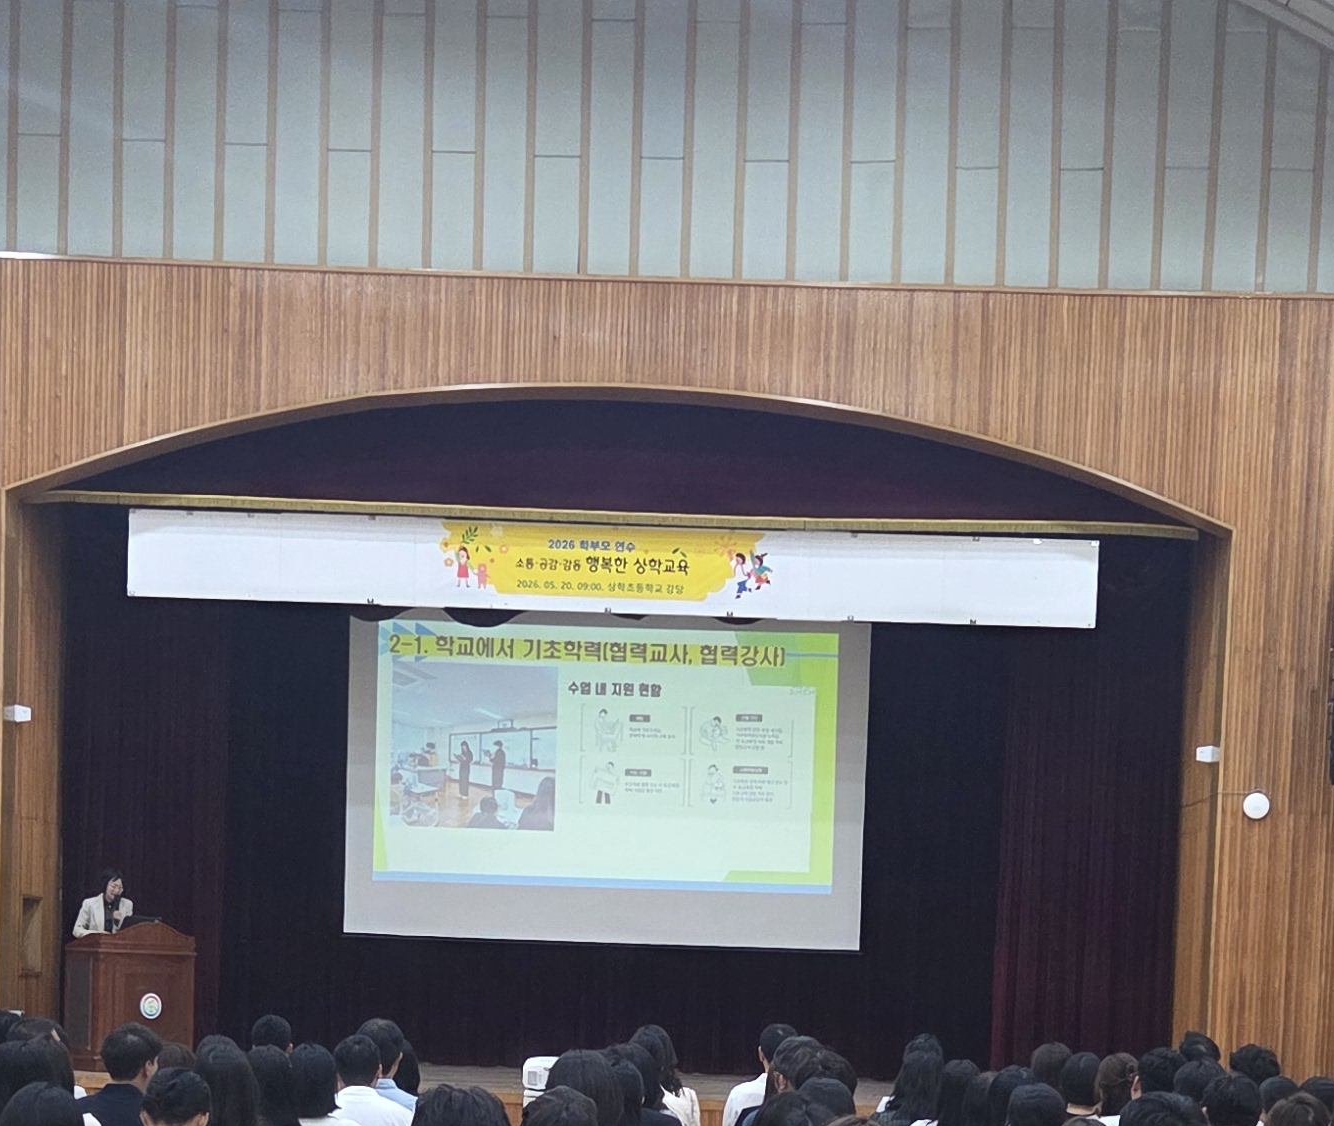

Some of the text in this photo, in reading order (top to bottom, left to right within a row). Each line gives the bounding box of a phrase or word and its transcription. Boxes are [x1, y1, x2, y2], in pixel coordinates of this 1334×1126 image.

[548, 539, 636, 553] 2026 학부모 연수
[585, 556, 628, 574] 행복한
[634, 557, 689, 576] 상학교육
[608, 582, 663, 594] 상학초등학교
[389, 634, 786, 668] 2-1. 학교에서 기초학력(협력교사, 협력강사)
[568, 681, 662, 698] 수업 내 지원 현황
